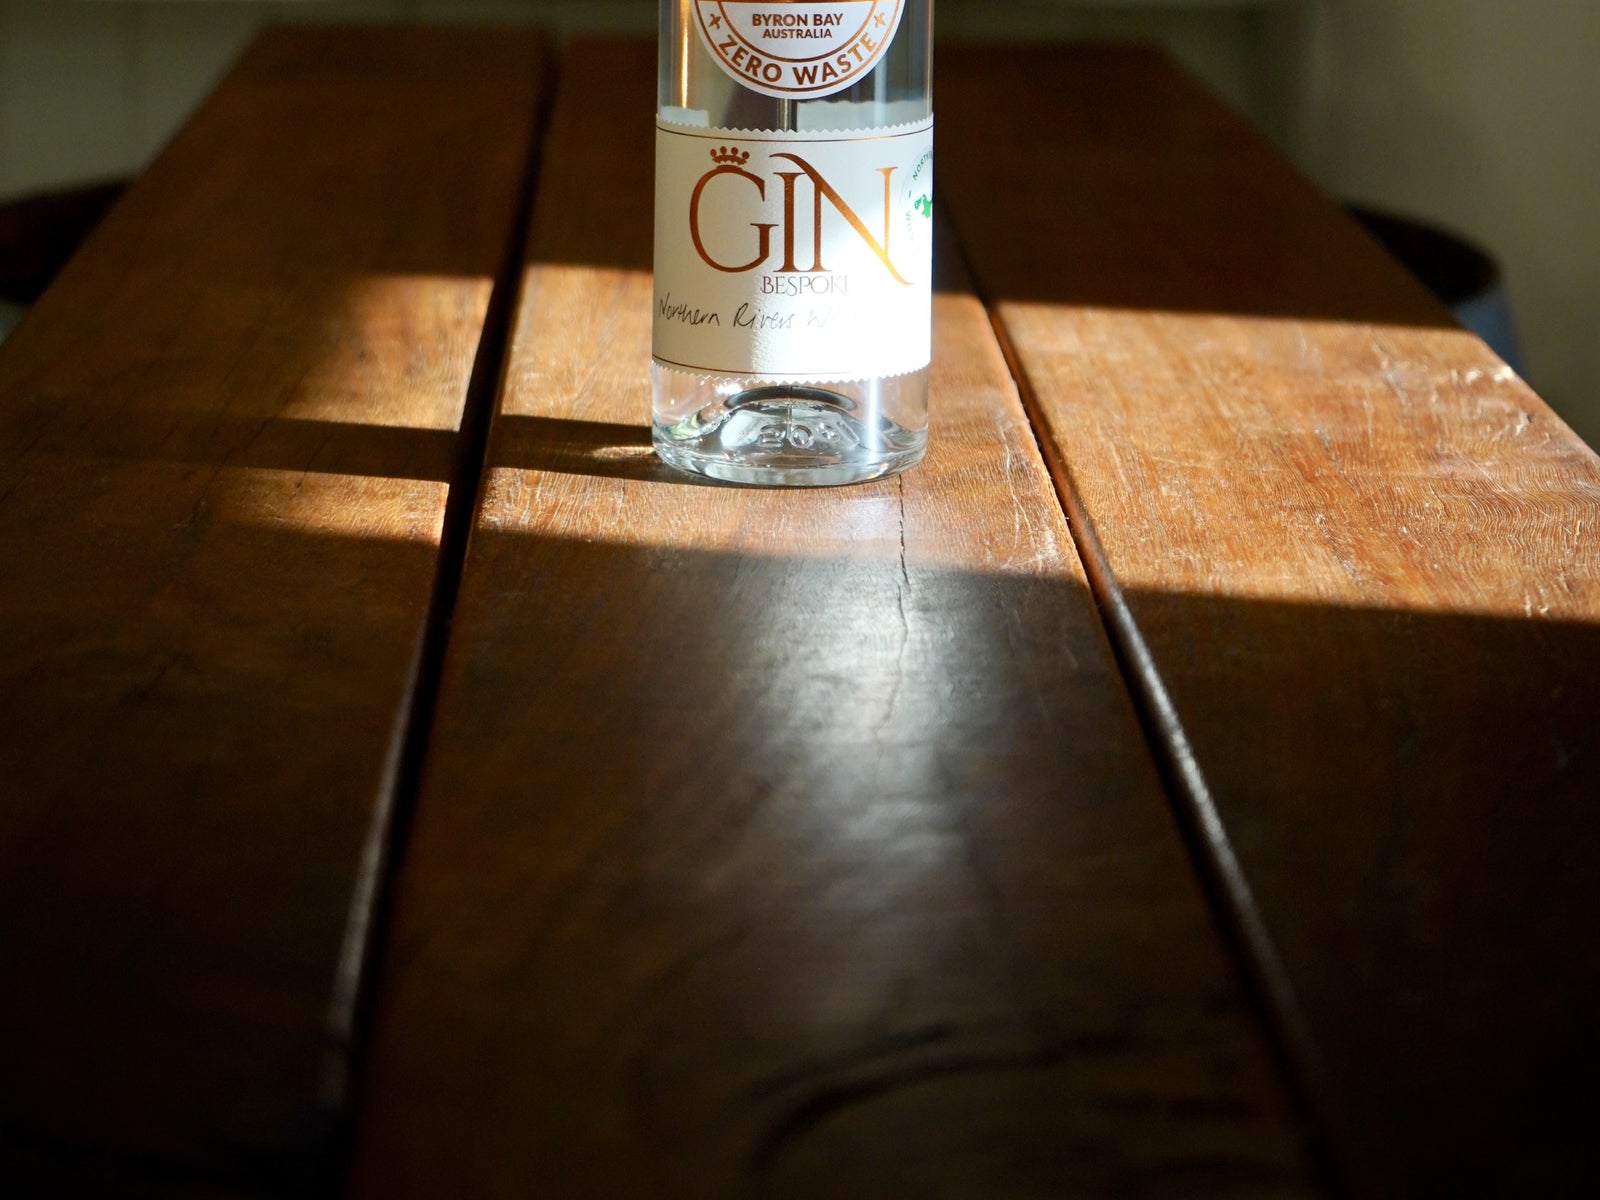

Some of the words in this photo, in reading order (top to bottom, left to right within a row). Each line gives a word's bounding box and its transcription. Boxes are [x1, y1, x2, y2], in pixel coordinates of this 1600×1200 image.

[752, 13, 808, 27] BYRON
[813, 13, 844, 27] BAY
[763, 28, 833, 39] AUSTRALIA
[718, 34, 782, 83] ZERO
[793, 32, 877, 86] WASTE
[689, 152, 915, 286] GIN
[658, 292, 720, 326] Northern
